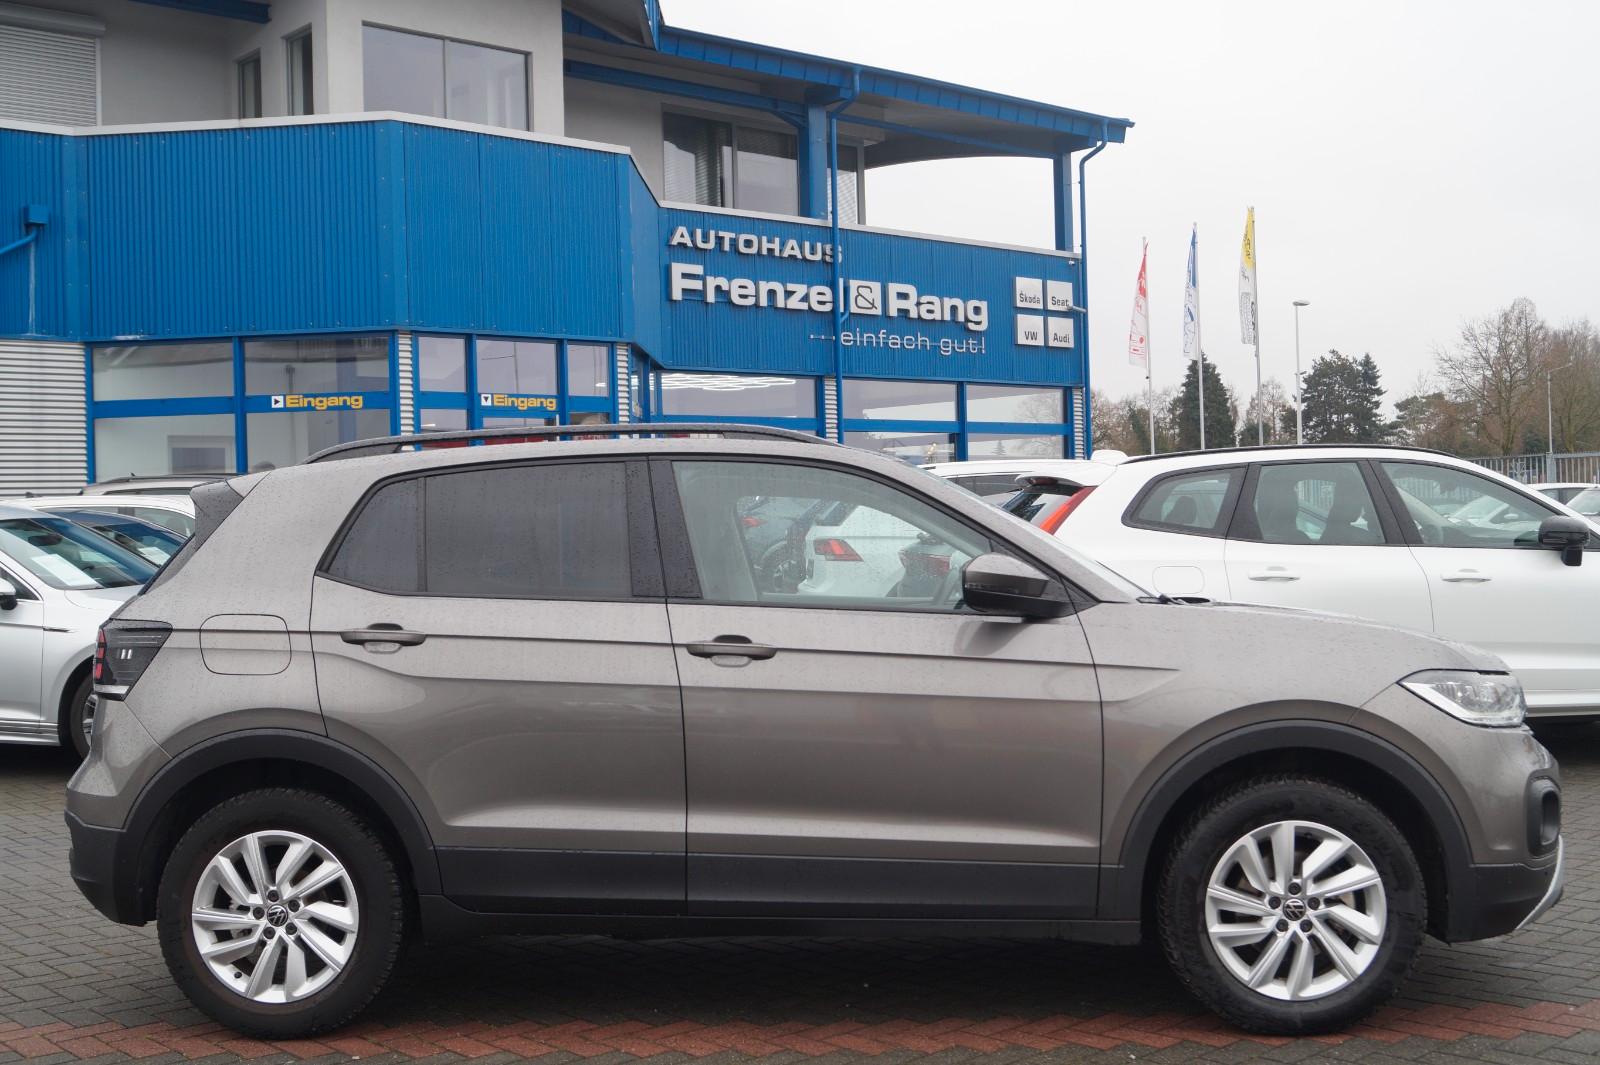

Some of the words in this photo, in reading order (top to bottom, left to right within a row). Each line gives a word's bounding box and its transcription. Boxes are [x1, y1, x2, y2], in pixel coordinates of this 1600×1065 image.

[670, 226, 842, 263] AUTOHAUS
[671, 262, 844, 312] Frenzel
[854, 284, 878, 310] &
[887, 282, 988, 331] Rang
[1051, 296, 1070, 307] Seat
[1024, 330, 1038, 341] VW
[1053, 332, 1070, 344] Audi
[940, 335, 986, 356] gut!
[286, 394, 363, 410] Eingang
[493, 394, 557, 410] Eingang
